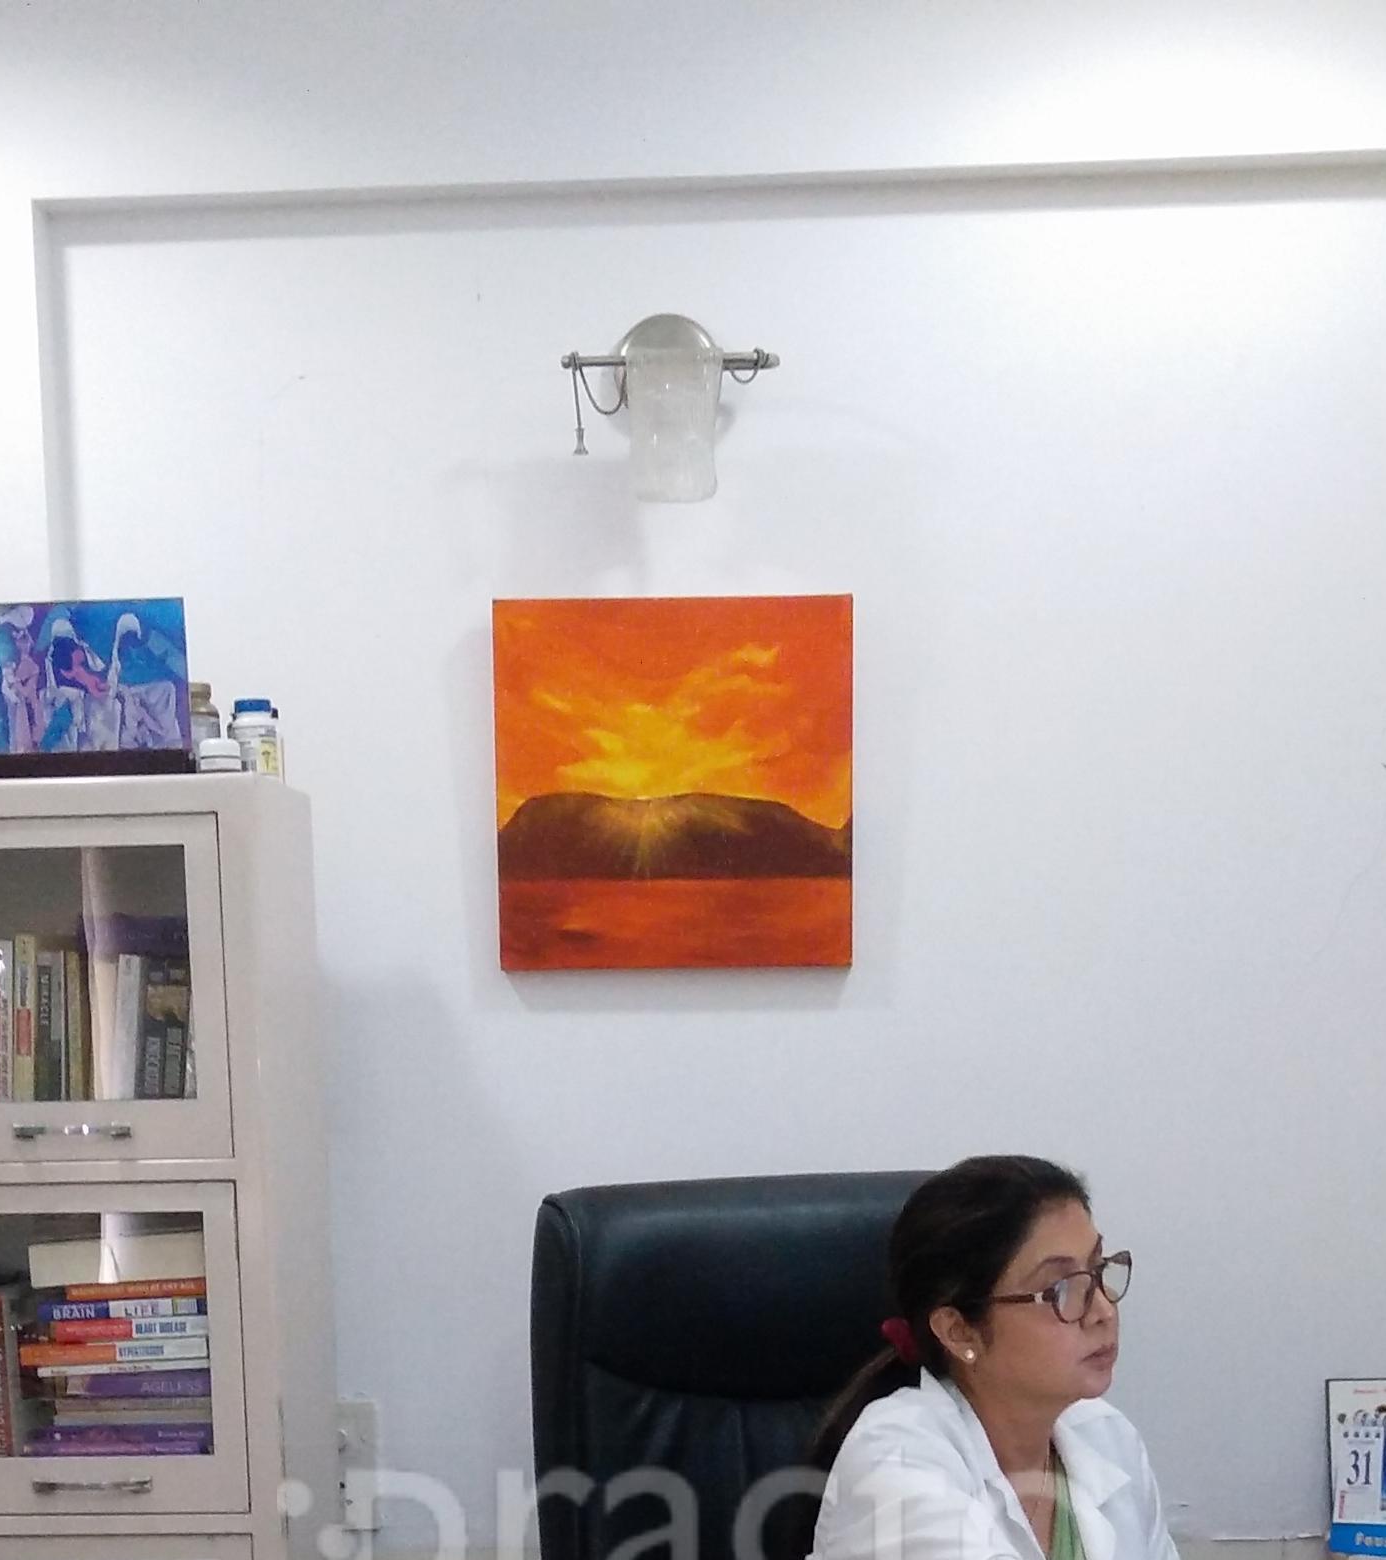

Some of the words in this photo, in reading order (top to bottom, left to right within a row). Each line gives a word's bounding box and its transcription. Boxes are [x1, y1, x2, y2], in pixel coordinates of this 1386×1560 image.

[53, 1303, 95, 1320] BRAIN
[135, 1322, 157, 1335] HEART
[1346, 1449, 1374, 1487] 31
